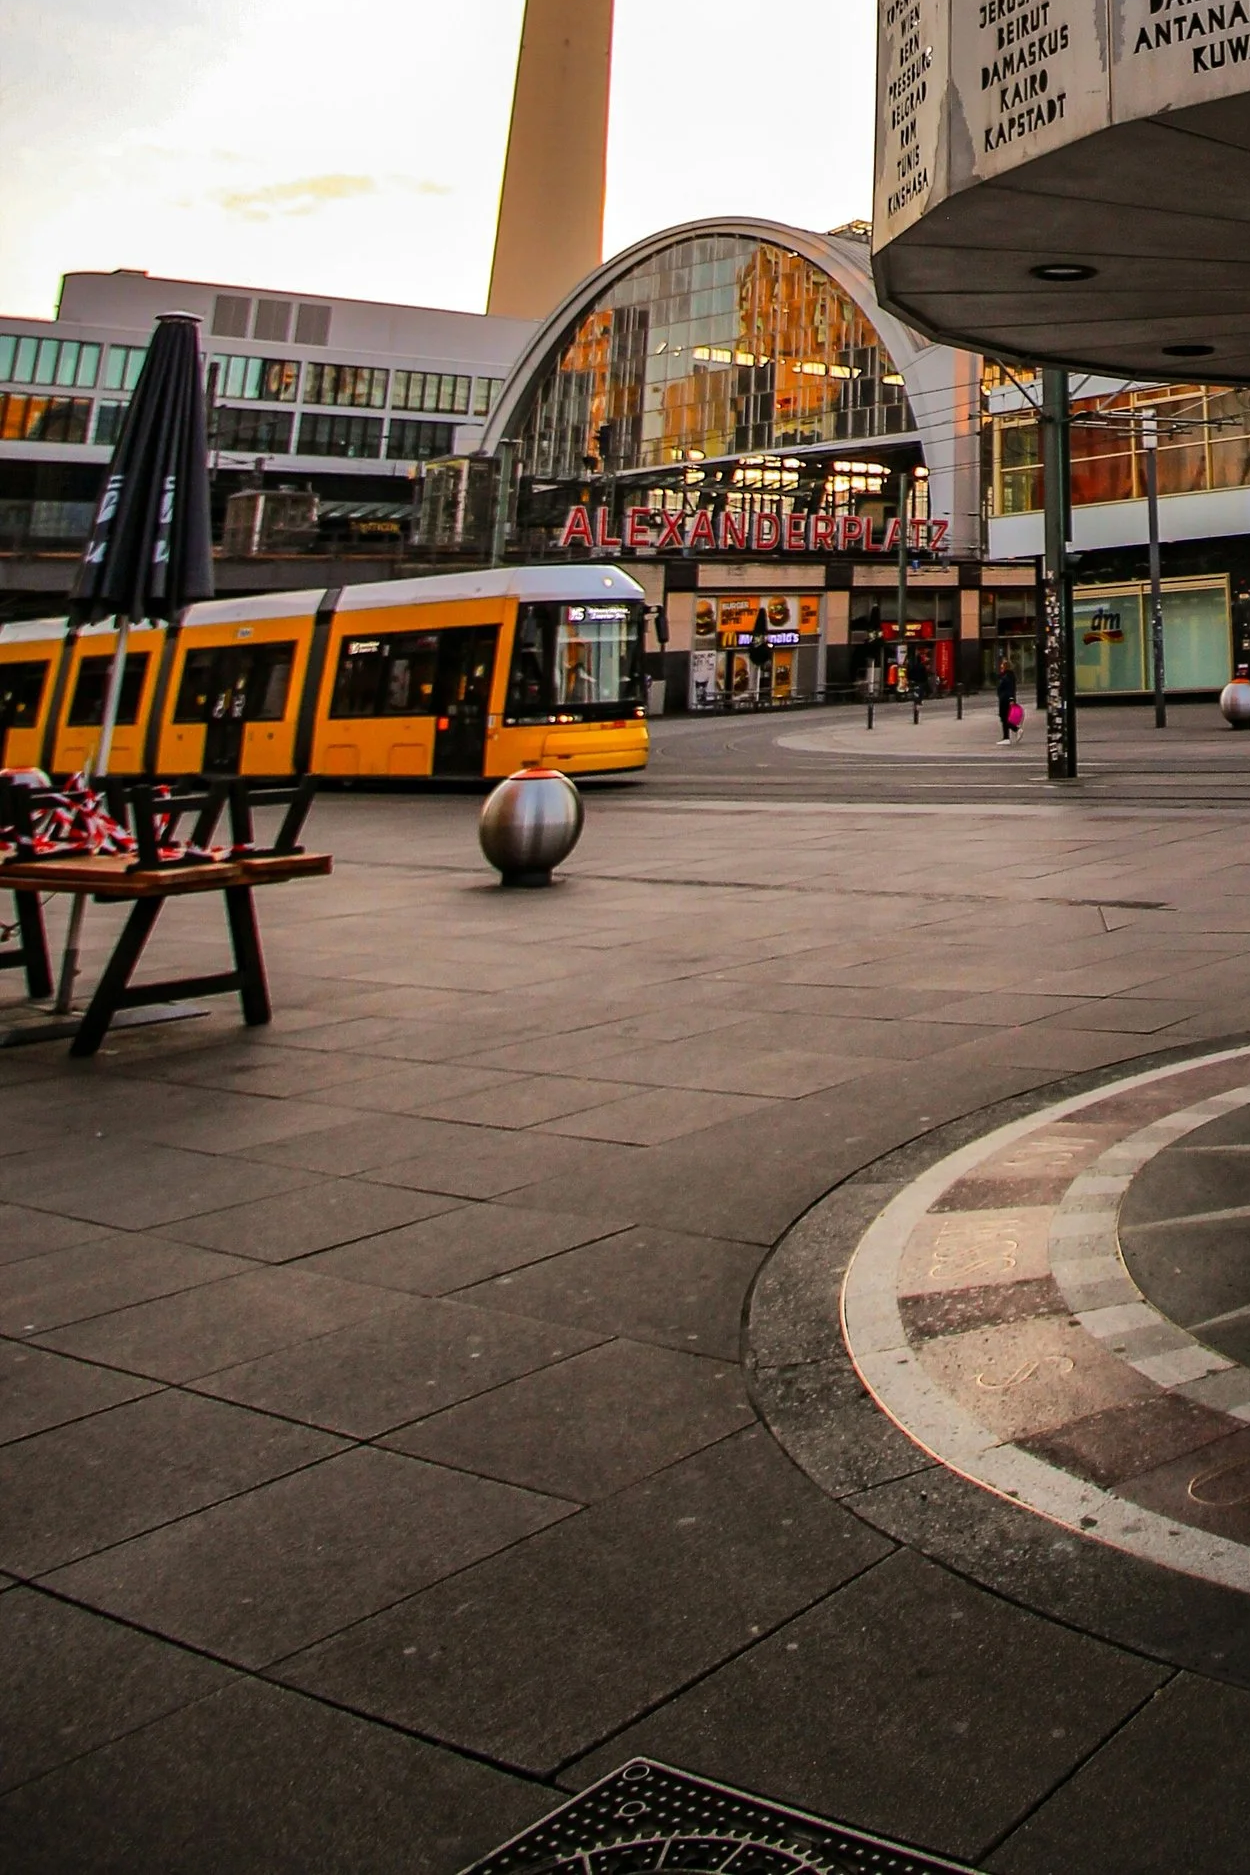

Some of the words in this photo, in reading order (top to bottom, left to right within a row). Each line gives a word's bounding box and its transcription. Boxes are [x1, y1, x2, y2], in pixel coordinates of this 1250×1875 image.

[900, 2, 921, 39] WIEN
[997, 2, 1050, 51] BEIRUT
[900, 30, 920, 68] BERN
[981, 25, 1069, 91] DAMASKUS
[888, 45, 934, 107] PRESSBURG
[1000, 68, 1049, 113] KAIRO
[892, 80, 927, 131] BELGRAD
[984, 93, 1066, 153] KAPSTADT
[900, 118, 917, 152] ROM
[897, 144, 920, 182] TUNIS
[887, 167, 929, 220] KINSHASA
[560, 505, 949, 552] ALEXANDERPLATZ
[1091, 607, 1120, 630] dm
